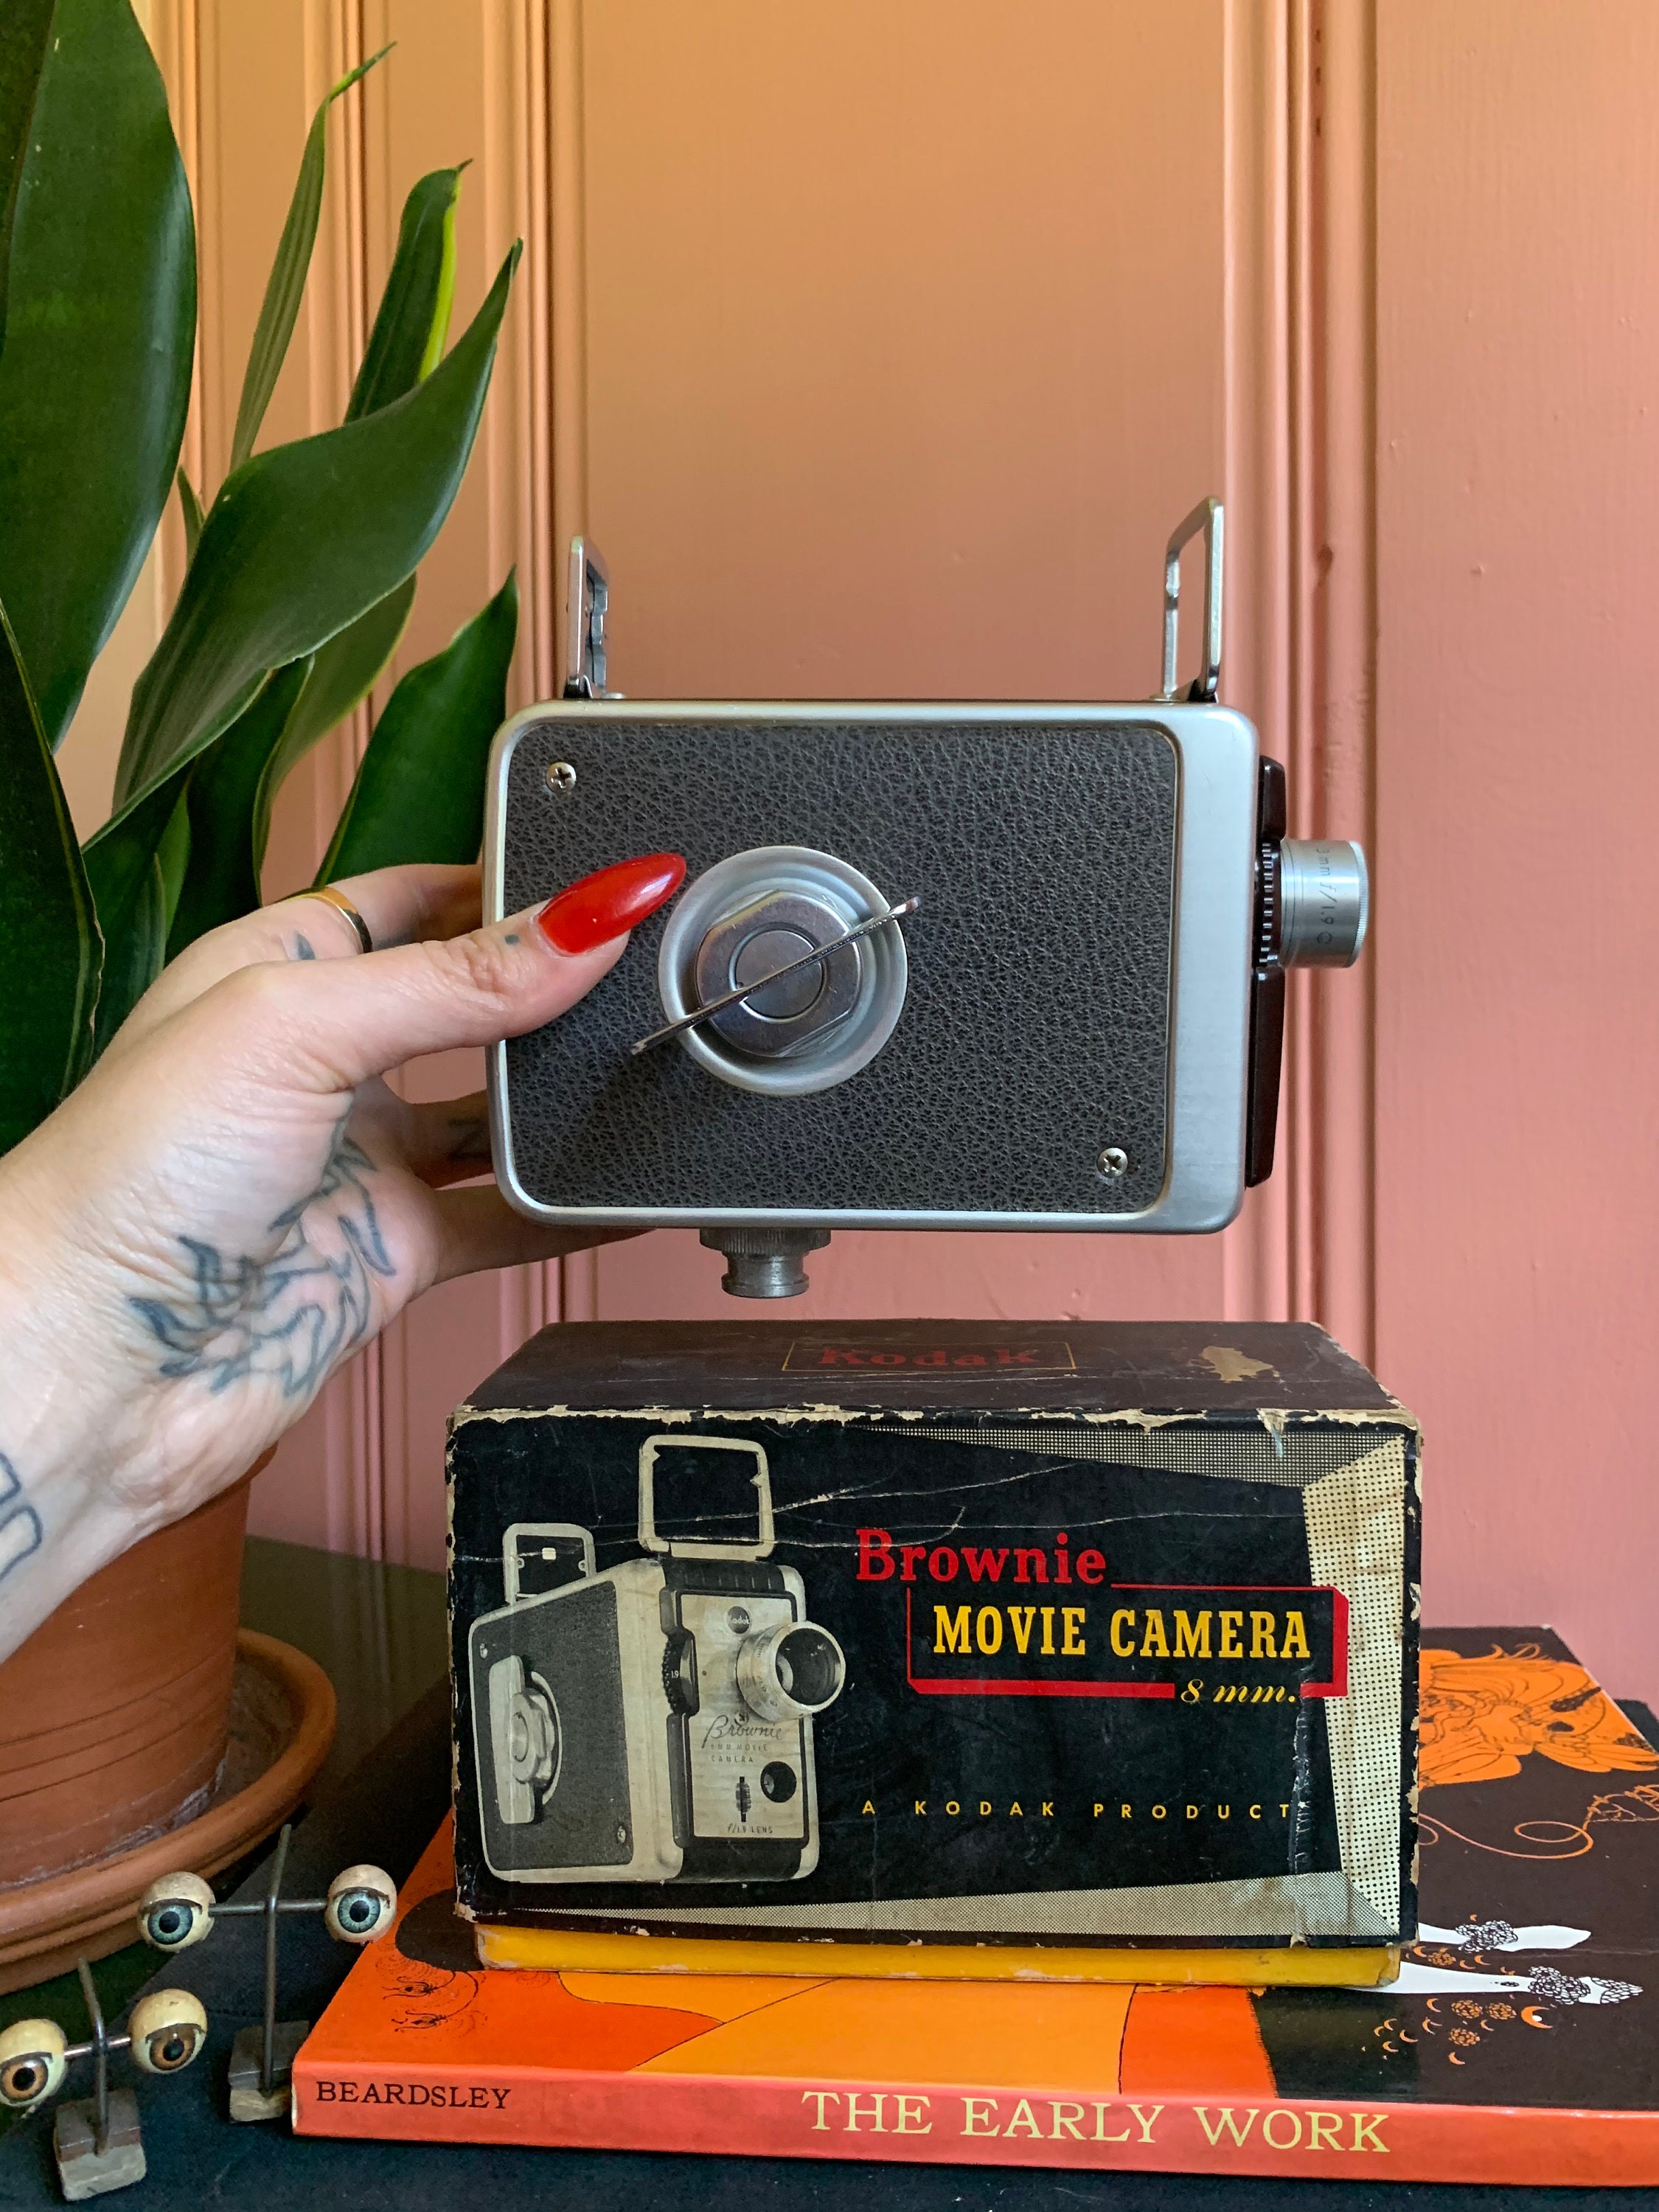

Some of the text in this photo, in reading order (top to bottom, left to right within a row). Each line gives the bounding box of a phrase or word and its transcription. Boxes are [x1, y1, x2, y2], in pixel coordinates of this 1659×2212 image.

[818, 1349, 1038, 1366] Kodak
[856, 1528, 1106, 1584] Brownie
[933, 1605, 1311, 1658] MOVIE CAMERA
[1180, 1679, 1295, 1703] 8 mm.
[701, 1714, 782, 1748] Brownie
[862, 1801, 1289, 1819] A KODAK PRODUCT
[751, 1826, 773, 1834] LENS
[316, 2081, 511, 2110] BEARDSLEY
[801, 2091, 1391, 2153] THE EARLY WORK
